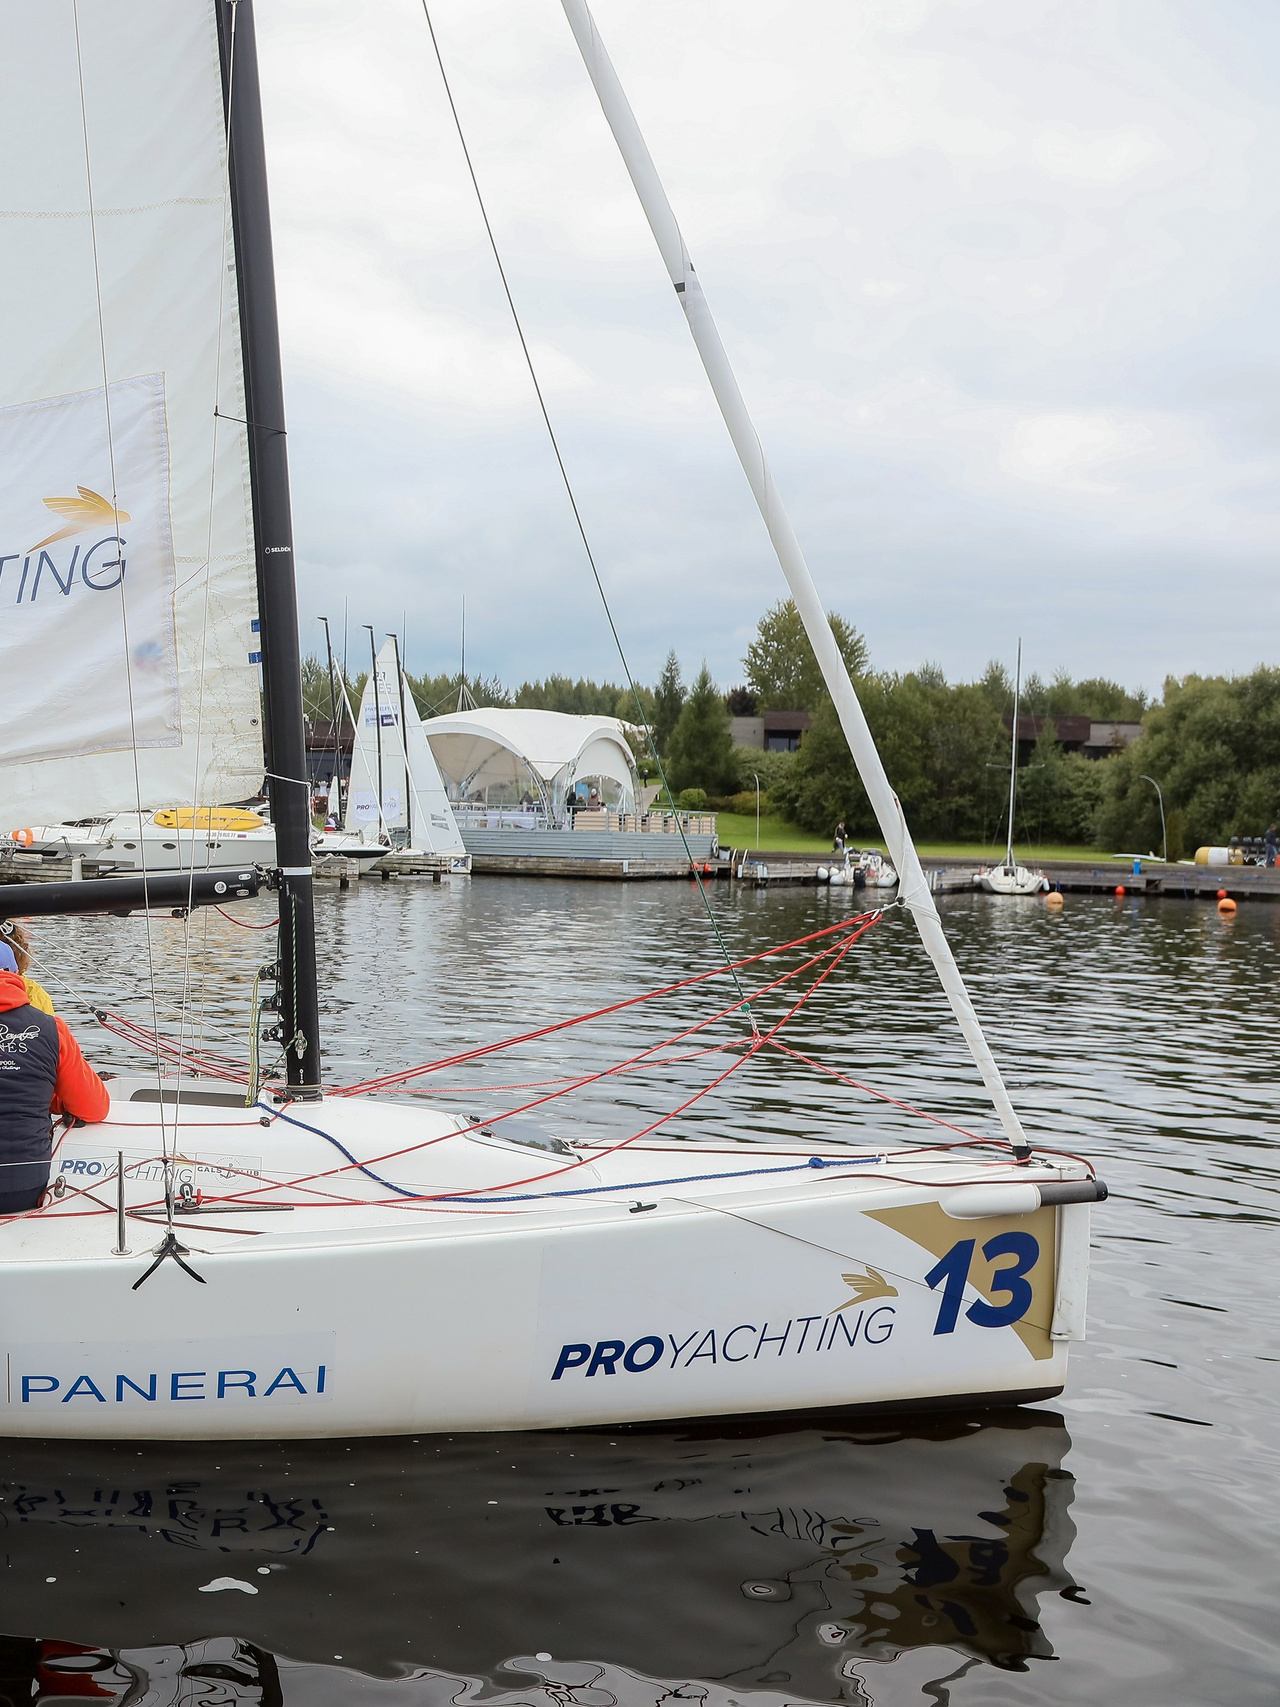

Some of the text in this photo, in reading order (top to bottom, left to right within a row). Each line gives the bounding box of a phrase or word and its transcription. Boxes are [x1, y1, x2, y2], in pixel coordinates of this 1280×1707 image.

[452, 858, 467, 868] 23
[923, 1230, 1041, 1337] 13
[550, 1305, 898, 1382] PROYACHTING
[20, 1365, 327, 1404] PANERAI
